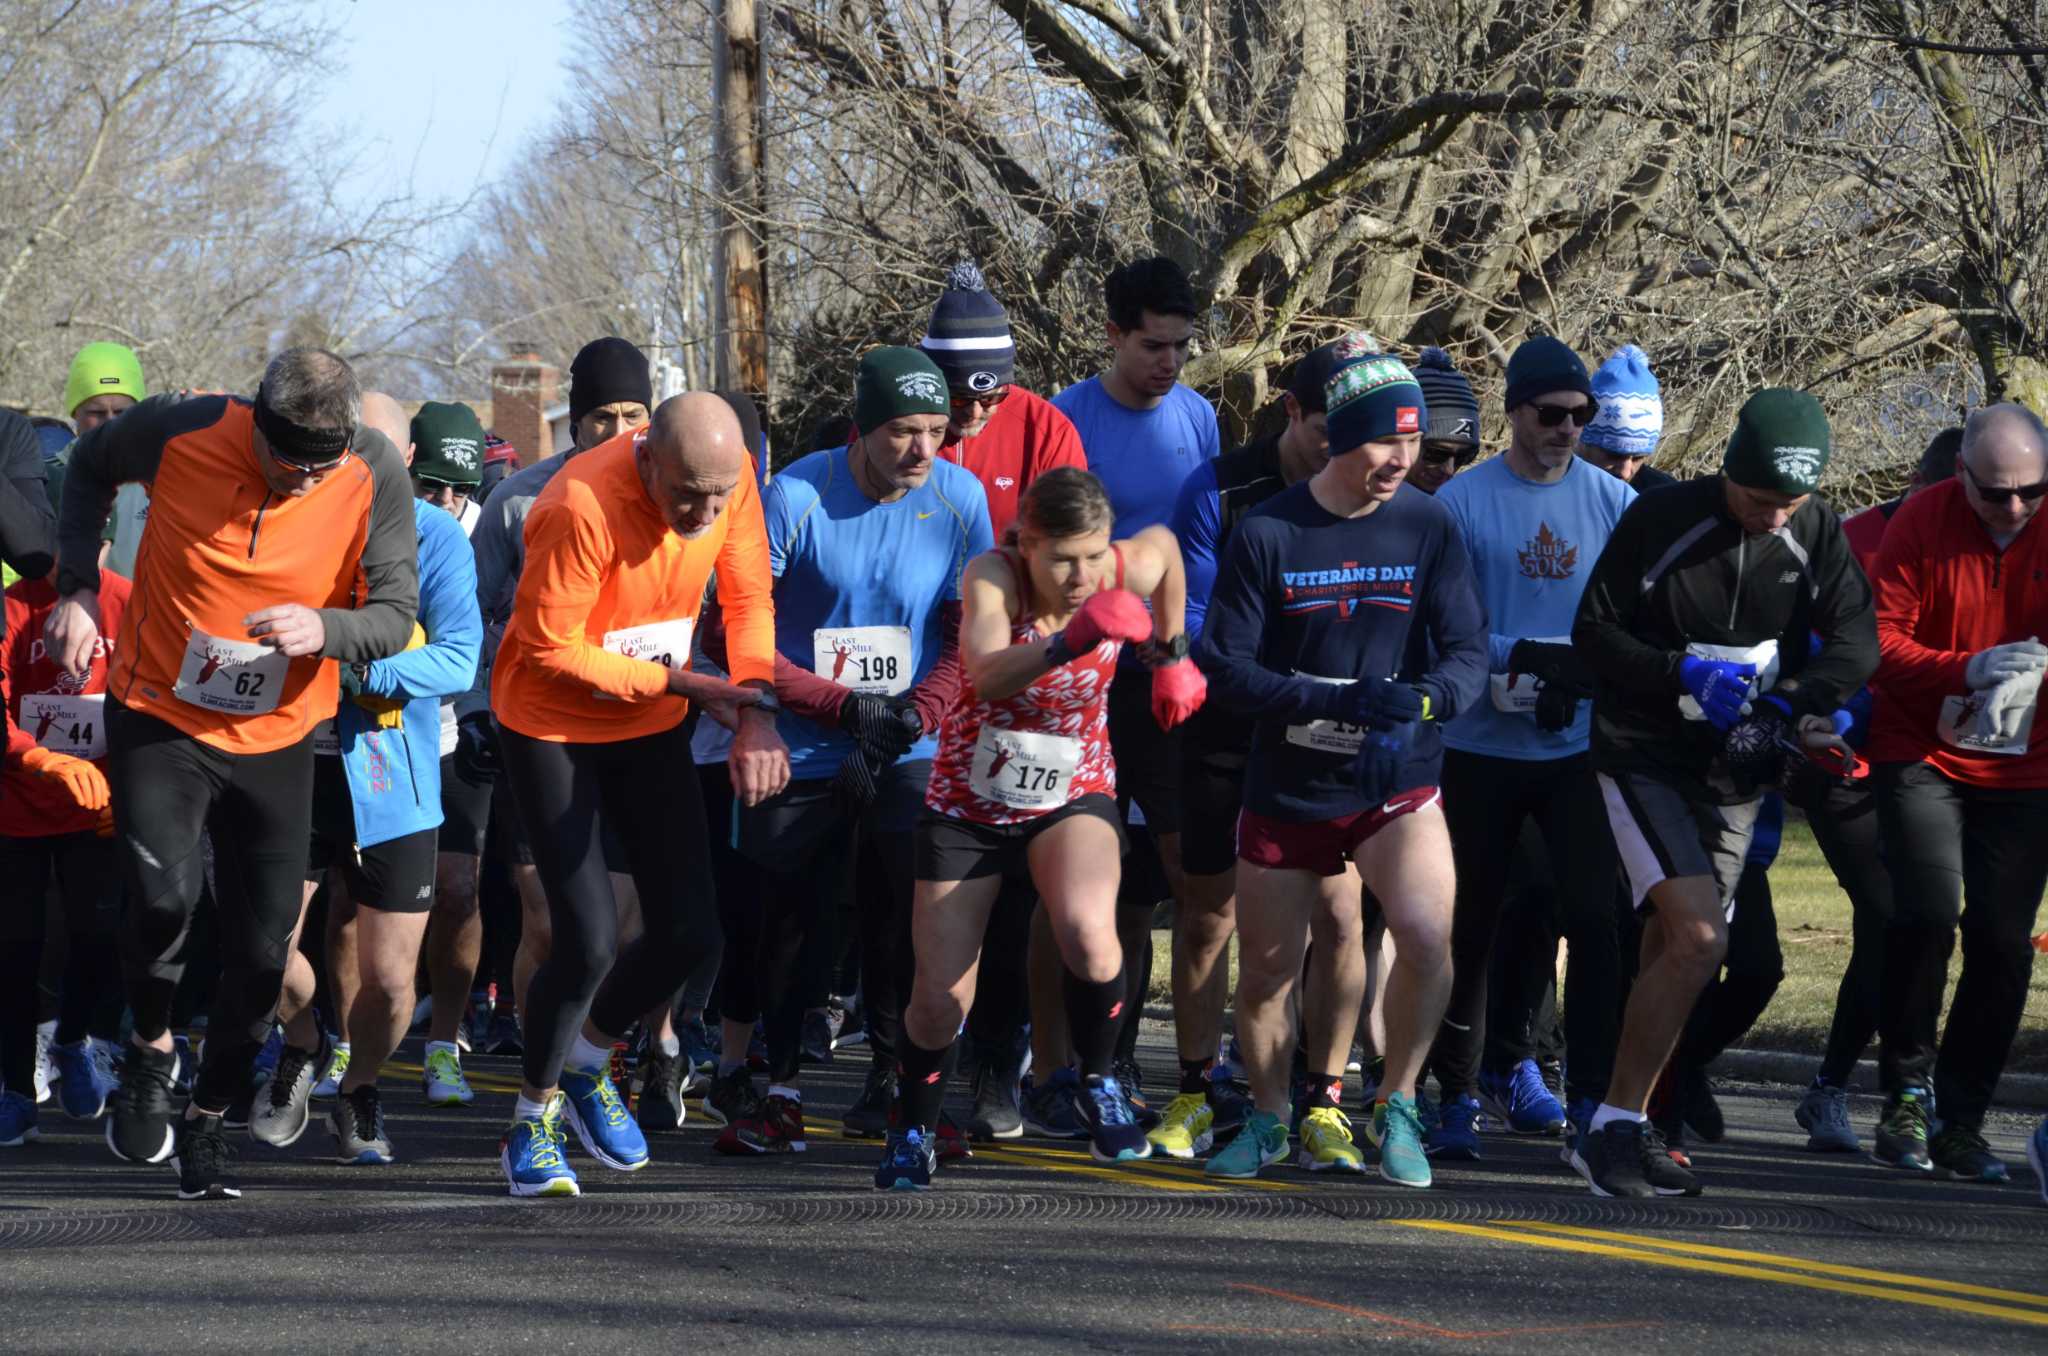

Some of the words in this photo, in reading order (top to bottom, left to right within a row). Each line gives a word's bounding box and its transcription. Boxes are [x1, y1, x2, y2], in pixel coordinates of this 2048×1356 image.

[1521, 557, 1569, 578] 50K
[1282, 566, 1377, 587] VETERANS
[1380, 565, 1417, 581] DAY
[835, 636, 857, 645] LAST
[207, 644, 233, 657] LAST
[852, 644, 873, 653] MILE
[222, 656, 249, 668] MILE
[859, 655, 898, 681] 198
[234, 671, 265, 697] 62
[39, 703, 62, 712] LAST
[56, 711, 78, 719] MILE
[68, 722, 93, 745] 44
[1014, 749, 1037, 761] MILE
[1015, 765, 1060, 791] 176
